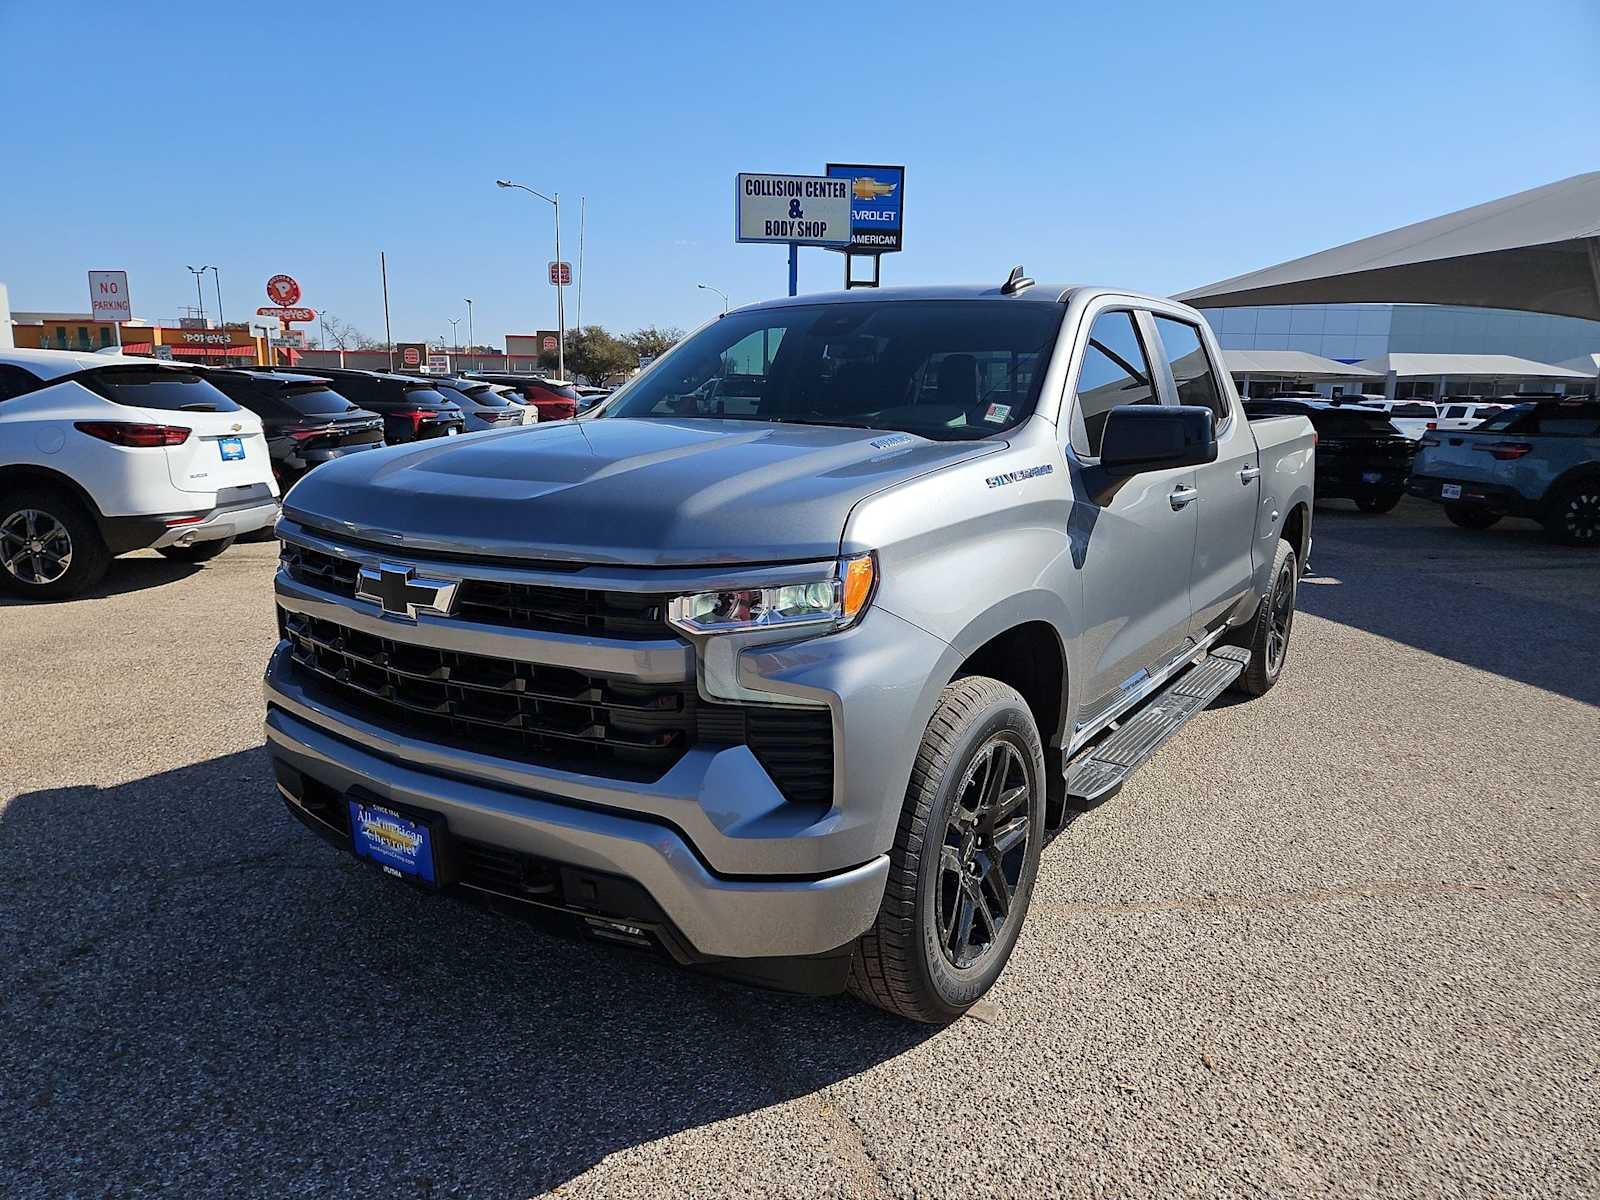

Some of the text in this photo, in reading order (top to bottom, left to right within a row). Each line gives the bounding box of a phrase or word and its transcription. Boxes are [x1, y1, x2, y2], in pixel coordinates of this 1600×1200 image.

[745, 179, 846, 198] COLLISION CENTER
[788, 198, 803, 219] &
[852, 210, 896, 221] EVROLET
[765, 220, 827, 238] BODY SHOP
[851, 235, 897, 245] AMERICAN
[100, 282, 118, 294] NO
[93, 301, 127, 311] PARKING
